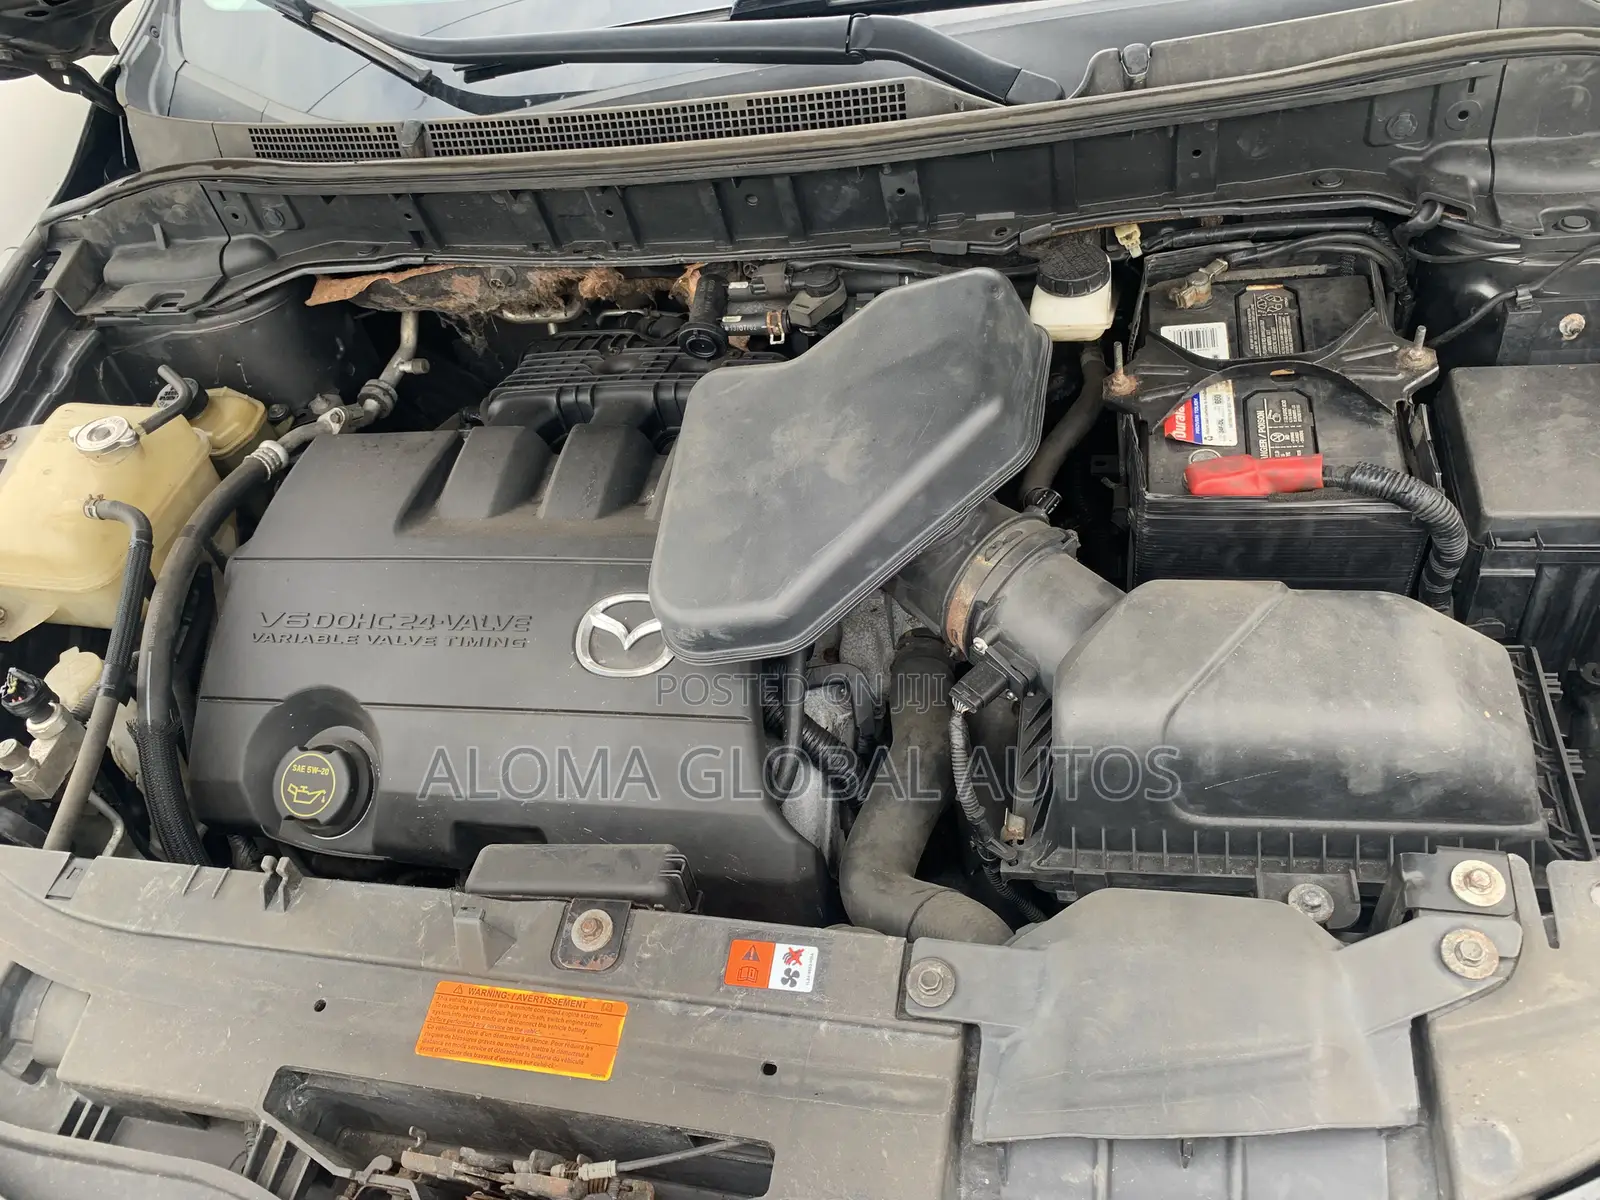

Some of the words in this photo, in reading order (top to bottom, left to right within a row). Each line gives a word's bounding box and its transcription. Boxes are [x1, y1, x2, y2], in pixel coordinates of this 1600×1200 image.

[1256, 410, 1266, 433] POISON
[252, 632, 360, 645] VARIABLE
[367, 634, 438, 647] VALVE
[446, 635, 528, 649] TIMING
[292, 764, 306, 773] SAE
[306, 765, 330, 776] 5W-20
[467, 988, 509, 999] WARNING:
[516, 994, 587, 1008] AVERTISSEMENT
